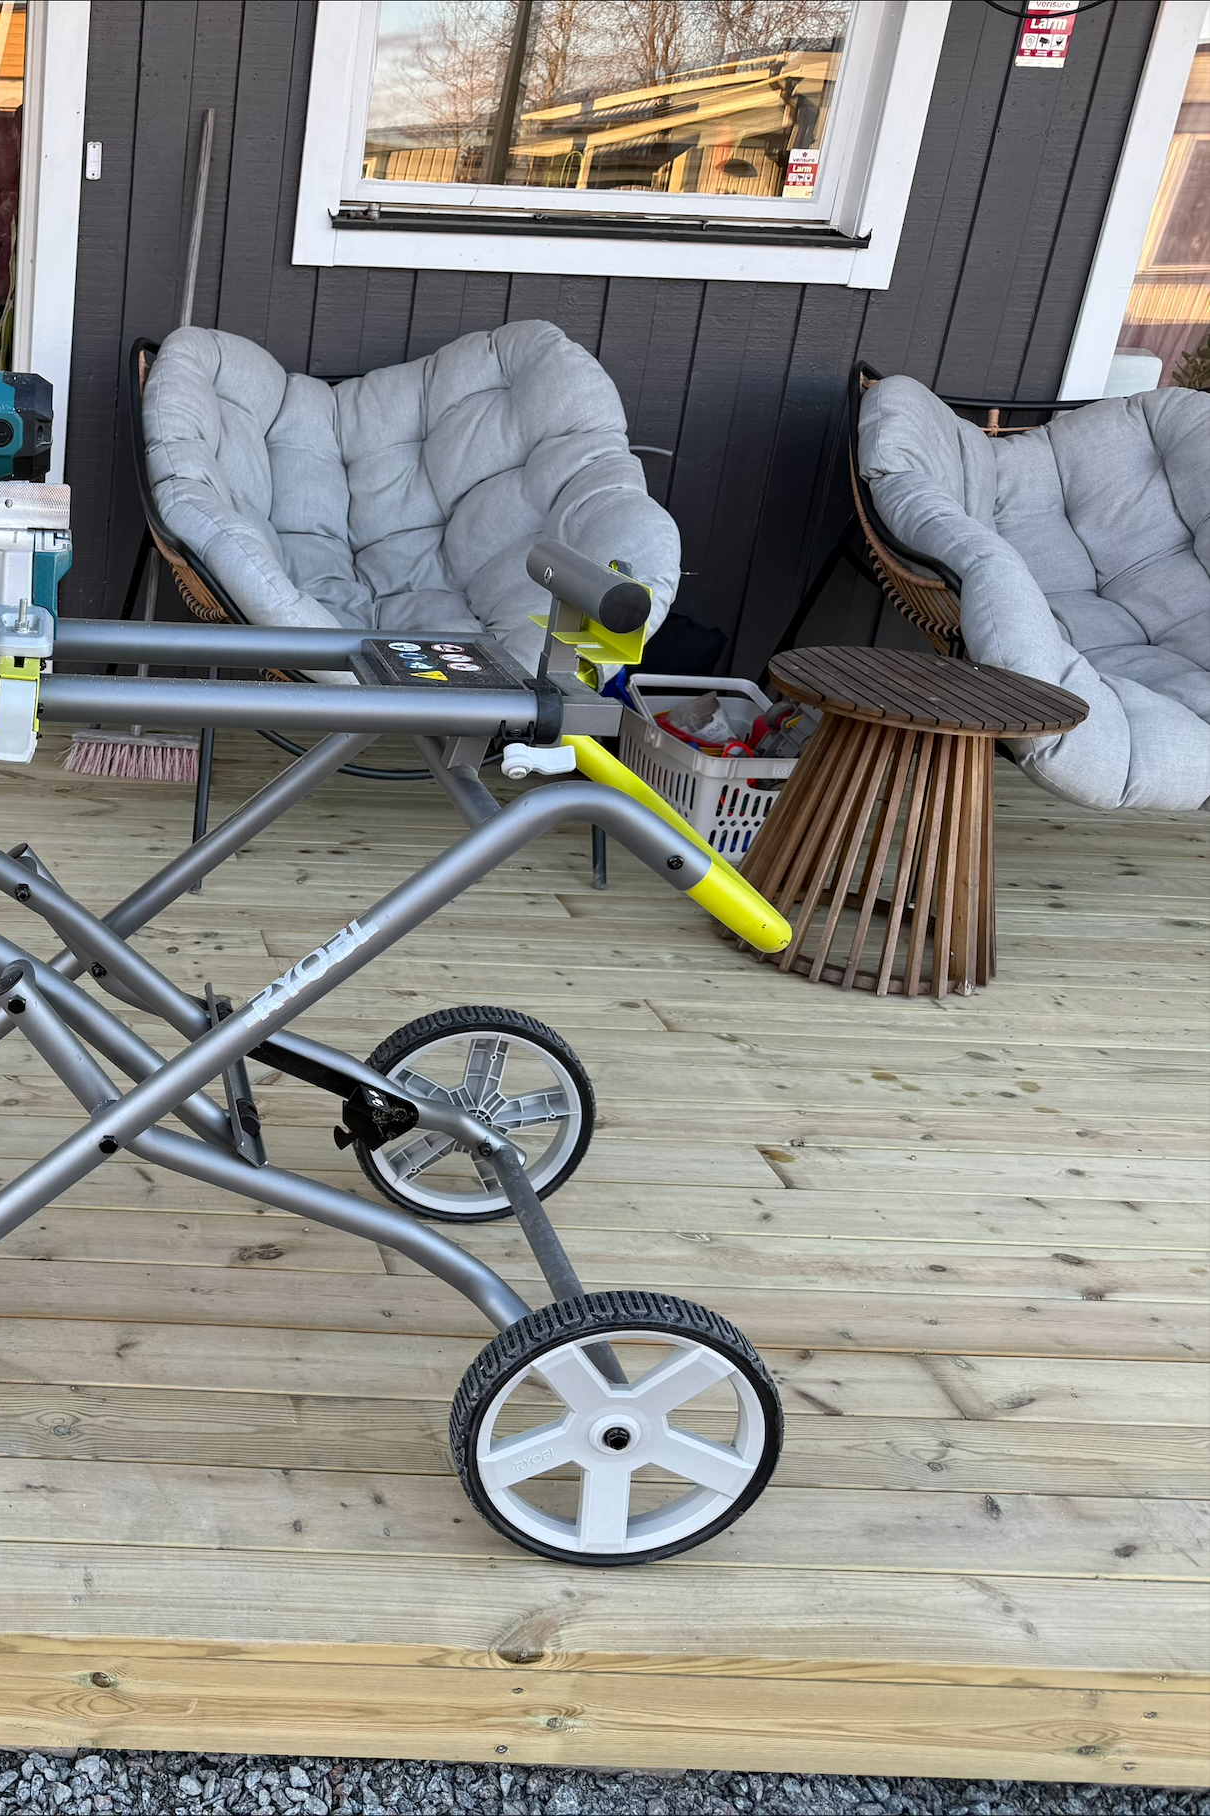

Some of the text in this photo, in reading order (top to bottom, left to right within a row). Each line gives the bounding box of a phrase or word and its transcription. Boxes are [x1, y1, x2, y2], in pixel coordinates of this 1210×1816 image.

[1030, 17, 1068, 31] Larm
[792, 164, 812, 173] Larm
[707, 721, 727, 737] Chalk
[246, 918, 372, 1021] RYOBI
[512, 1447, 556, 1472] RYOBI
